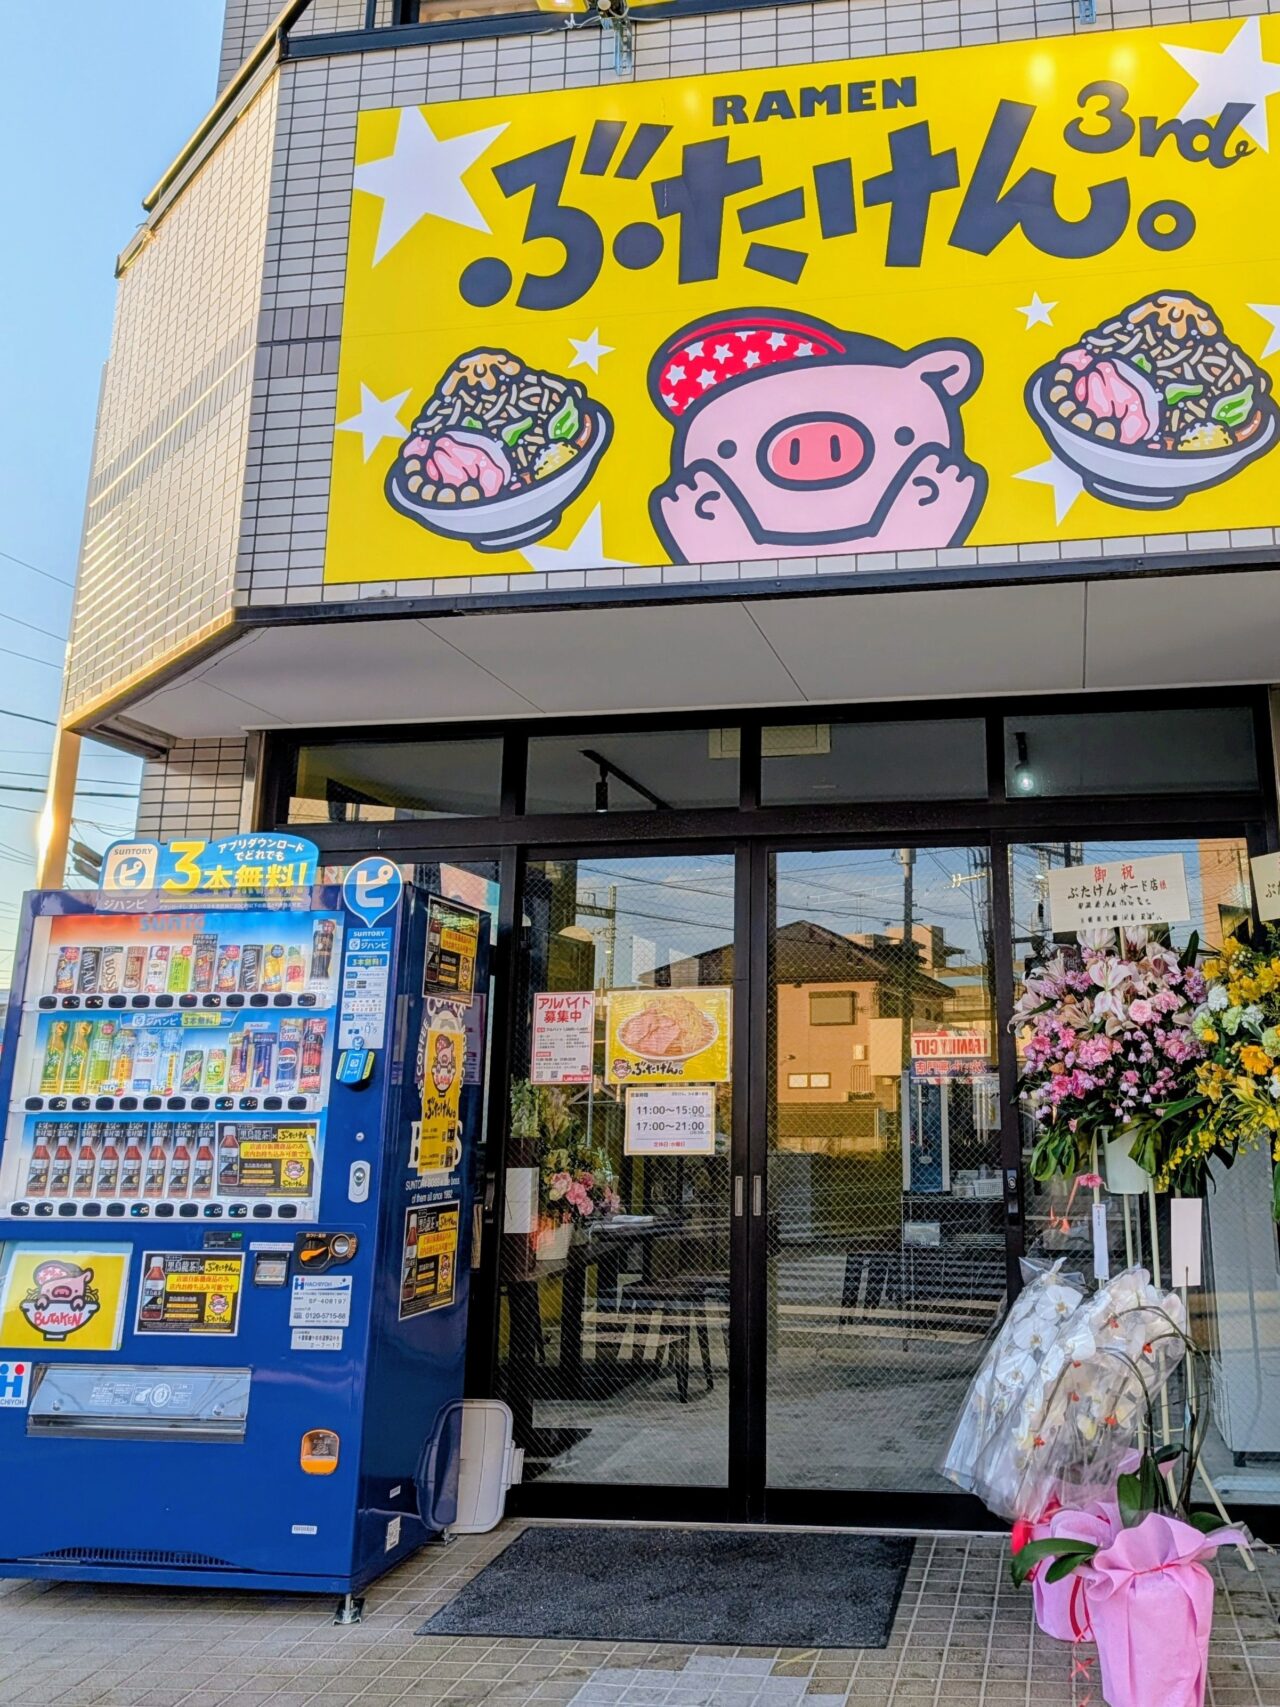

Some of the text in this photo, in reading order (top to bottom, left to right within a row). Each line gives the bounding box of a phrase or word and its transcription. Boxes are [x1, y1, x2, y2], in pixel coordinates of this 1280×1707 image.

[713, 76, 918, 126] RAMEN
[1064, 80, 1257, 168] 3rd
[459, 100, 1197, 311] ぶたけん。
[114, 847, 153, 856] SUNTORY
[217, 837, 305, 853] アプリダウンロード
[234, 851, 286, 862] でどれでも
[355, 864, 394, 908] ピ
[105, 958, 118, 992] BOSS
[538, 996, 591, 1010] アルバイト
[544, 1010, 582, 1023] 募集中
[631, 1061, 684, 1076] ぶたけん。
[636, 1105, 705, 1115] 11:00〜15:00
[636, 1121, 705, 1131] 17:00〜21:00
[34, 1311, 83, 1327] BUTAKEN
